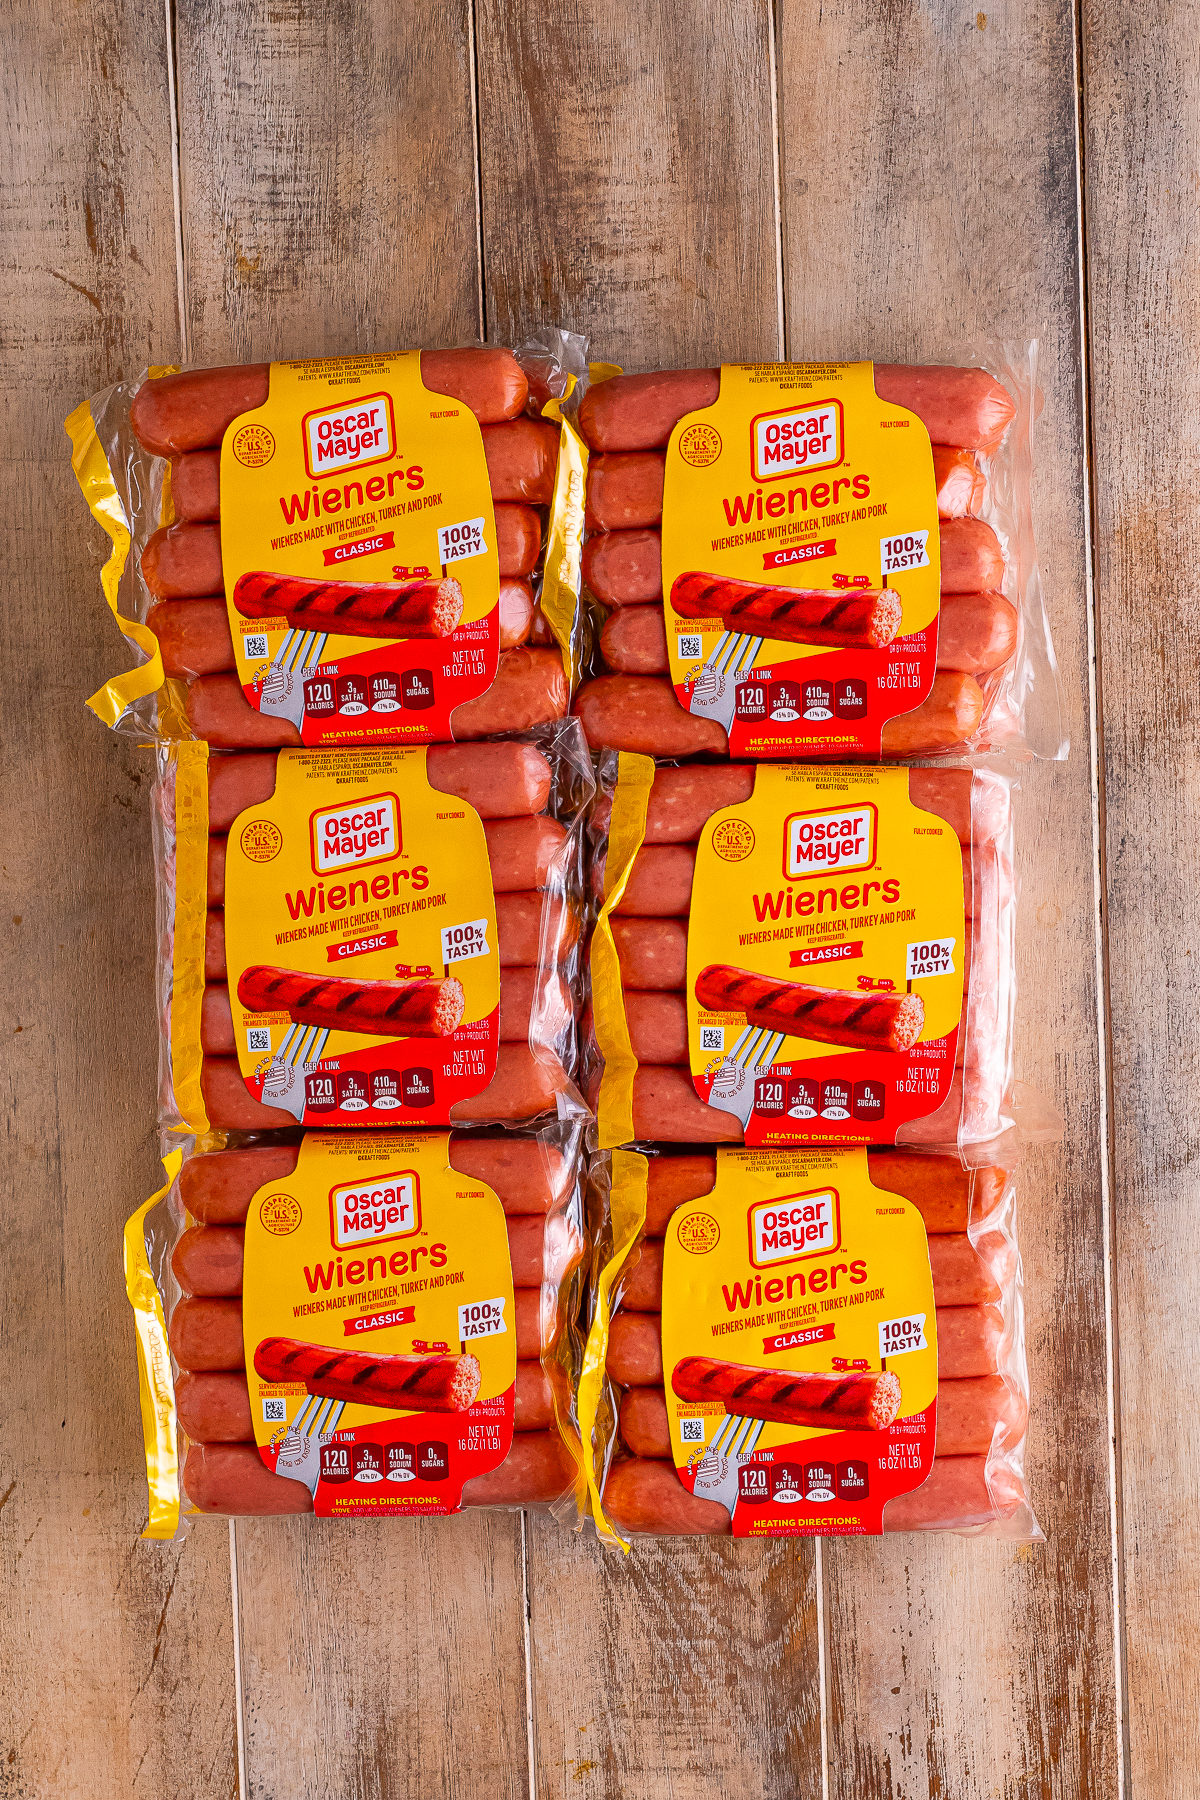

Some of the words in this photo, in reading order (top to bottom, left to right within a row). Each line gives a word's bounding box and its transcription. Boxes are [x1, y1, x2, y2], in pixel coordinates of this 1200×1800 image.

[318, 408, 379, 440] Oscar
[766, 415, 829, 444] Oscar
[317, 428, 384, 462] Mayer
[764, 434, 832, 465] Mayer
[279, 466, 424, 525] Wieners
[723, 474, 870, 526] Wieners
[270, 532, 303, 550] WIENERS
[304, 526, 324, 541] MADE
[325, 520, 344, 536] WITH
[345, 512, 378, 530] CHICKEN,
[378, 503, 406, 521] TURKEY
[408, 499, 422, 513] AND
[423, 493, 442, 509] PORK
[711, 534, 744, 551] WIENERS
[745, 529, 766, 544] MADE
[767, 525, 786, 540] WITH
[788, 518, 821, 535] CHICKEN,
[821, 511, 850, 528] TURKEY
[851, 508, 866, 522] AND
[868, 503, 887, 518] PORK
[442, 525, 480, 545] 100%
[334, 538, 384, 559] CLASSIC
[443, 539, 481, 559] TASTY
[775, 545, 825, 563] CLASSIC
[884, 536, 923, 556] 100%
[885, 551, 924, 570] TASTY
[452, 650, 469, 663] NET
[470, 649, 484, 662] WT
[302, 667, 316, 677] PER
[323, 665, 339, 675] LINK
[888, 663, 905, 675] NET
[906, 662, 920, 674] WT
[307, 683, 332, 702] 120
[406, 687, 429, 696] SUGARS
[877, 676, 885, 689] 16
[887, 676, 898, 688] OZ
[374, 690, 396, 699] SODIUM
[307, 701, 334, 710] CALORIES
[322, 730, 364, 739] HEATING
[366, 725, 428, 736] DIRECTIONS:
[325, 808, 386, 838] Oscar
[799, 818, 863, 843] Oscar
[323, 827, 390, 859] Mayer
[796, 837, 865, 865] Mayer
[285, 866, 429, 920] Wieners
[753, 879, 900, 922] Wieners
[275, 928, 307, 945] WIENERS
[308, 922, 329, 937] MADE
[330, 917, 348, 932] WITH
[350, 910, 382, 927] CHICKEN,
[382, 902, 410, 919] TURKEY
[412, 898, 426, 912] AND
[427, 893, 446, 909] PORK
[739, 931, 772, 946] WIENERS
[773, 927, 794, 940] MADE
[795, 924, 814, 938] WITH
[816, 920, 849, 934] CHICKEN,
[850, 914, 878, 929] TURKEY
[879, 912, 894, 925] AND
[896, 909, 916, 923] PORK
[338, 936, 387, 956] CLASSIC
[445, 926, 483, 946] 100%
[446, 940, 484, 959] TASTY
[801, 946, 852, 962] CLASSIC
[911, 943, 950, 961] 100%
[910, 959, 950, 975] TASTY
[308, 1079, 332, 1096] 120
[758, 1084, 782, 1101] 120
[308, 1096, 334, 1105] CALORIES
[756, 1100, 783, 1109] CALORIES
[824, 1098, 847, 1106] SODIUM
[857, 1098, 880, 1107] SUGARS
[344, 1185, 406, 1213] Oscar
[342, 1204, 409, 1234] Mayer
[763, 1202, 825, 1231] Oscar
[761, 1221, 829, 1252] Mayer
[303, 1243, 447, 1293] Wieners
[293, 1301, 325, 1317] WIENERS
[326, 1296, 346, 1310] MADE
[348, 1292, 366, 1306] WITH
[368, 1286, 400, 1302] CHICKEN,
[400, 1279, 428, 1295] TURKEY
[429, 1276, 444, 1289] AND
[445, 1271, 464, 1286] PORK
[722, 1260, 867, 1312] Wieners
[354, 1311, 404, 1329] CLASSIC
[462, 1304, 500, 1323] 100%
[711, 1320, 743, 1336] WIENERS
[745, 1314, 765, 1329] MADE
[766, 1310, 785, 1324] WITH
[787, 1303, 819, 1320] CHICKEN,
[820, 1296, 848, 1312] TURKEY
[849, 1292, 864, 1306] AND
[865, 1288, 884, 1303] PORK
[463, 1318, 501, 1336] TASTY
[882, 1320, 921, 1340] 100%
[774, 1329, 824, 1348] CLASSIC
[883, 1334, 922, 1353] TASTY
[468, 1426, 485, 1438] NET
[485, 1426, 500, 1437] WT
[323, 1450, 347, 1467] 120
[754, 1519, 796, 1528] HEATING
[798, 1517, 860, 1526] DIRECTIONS:
